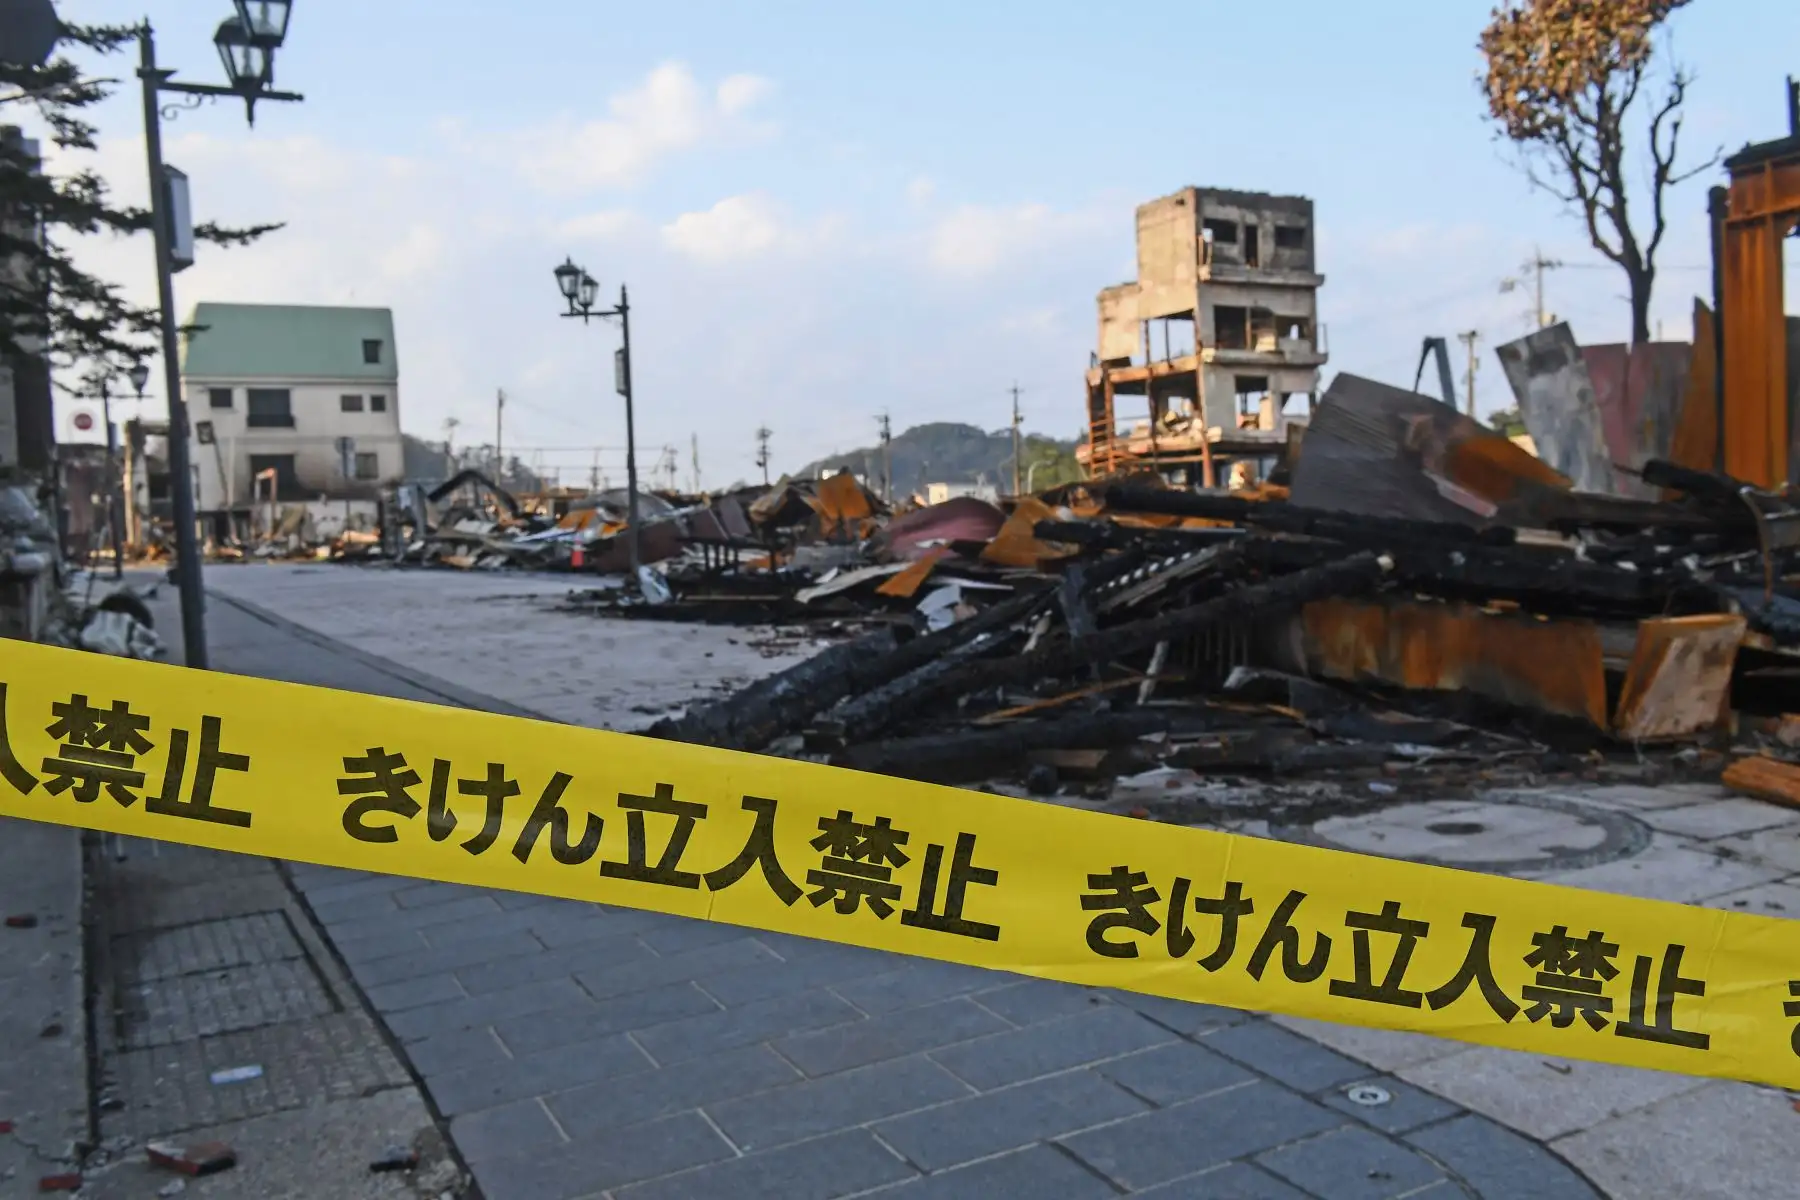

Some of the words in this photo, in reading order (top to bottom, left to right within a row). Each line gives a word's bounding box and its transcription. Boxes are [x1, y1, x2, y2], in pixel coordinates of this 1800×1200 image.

[337, 747, 1000, 941] きけん立入禁止
[1080, 866, 1710, 1050] きけん立入禁止
